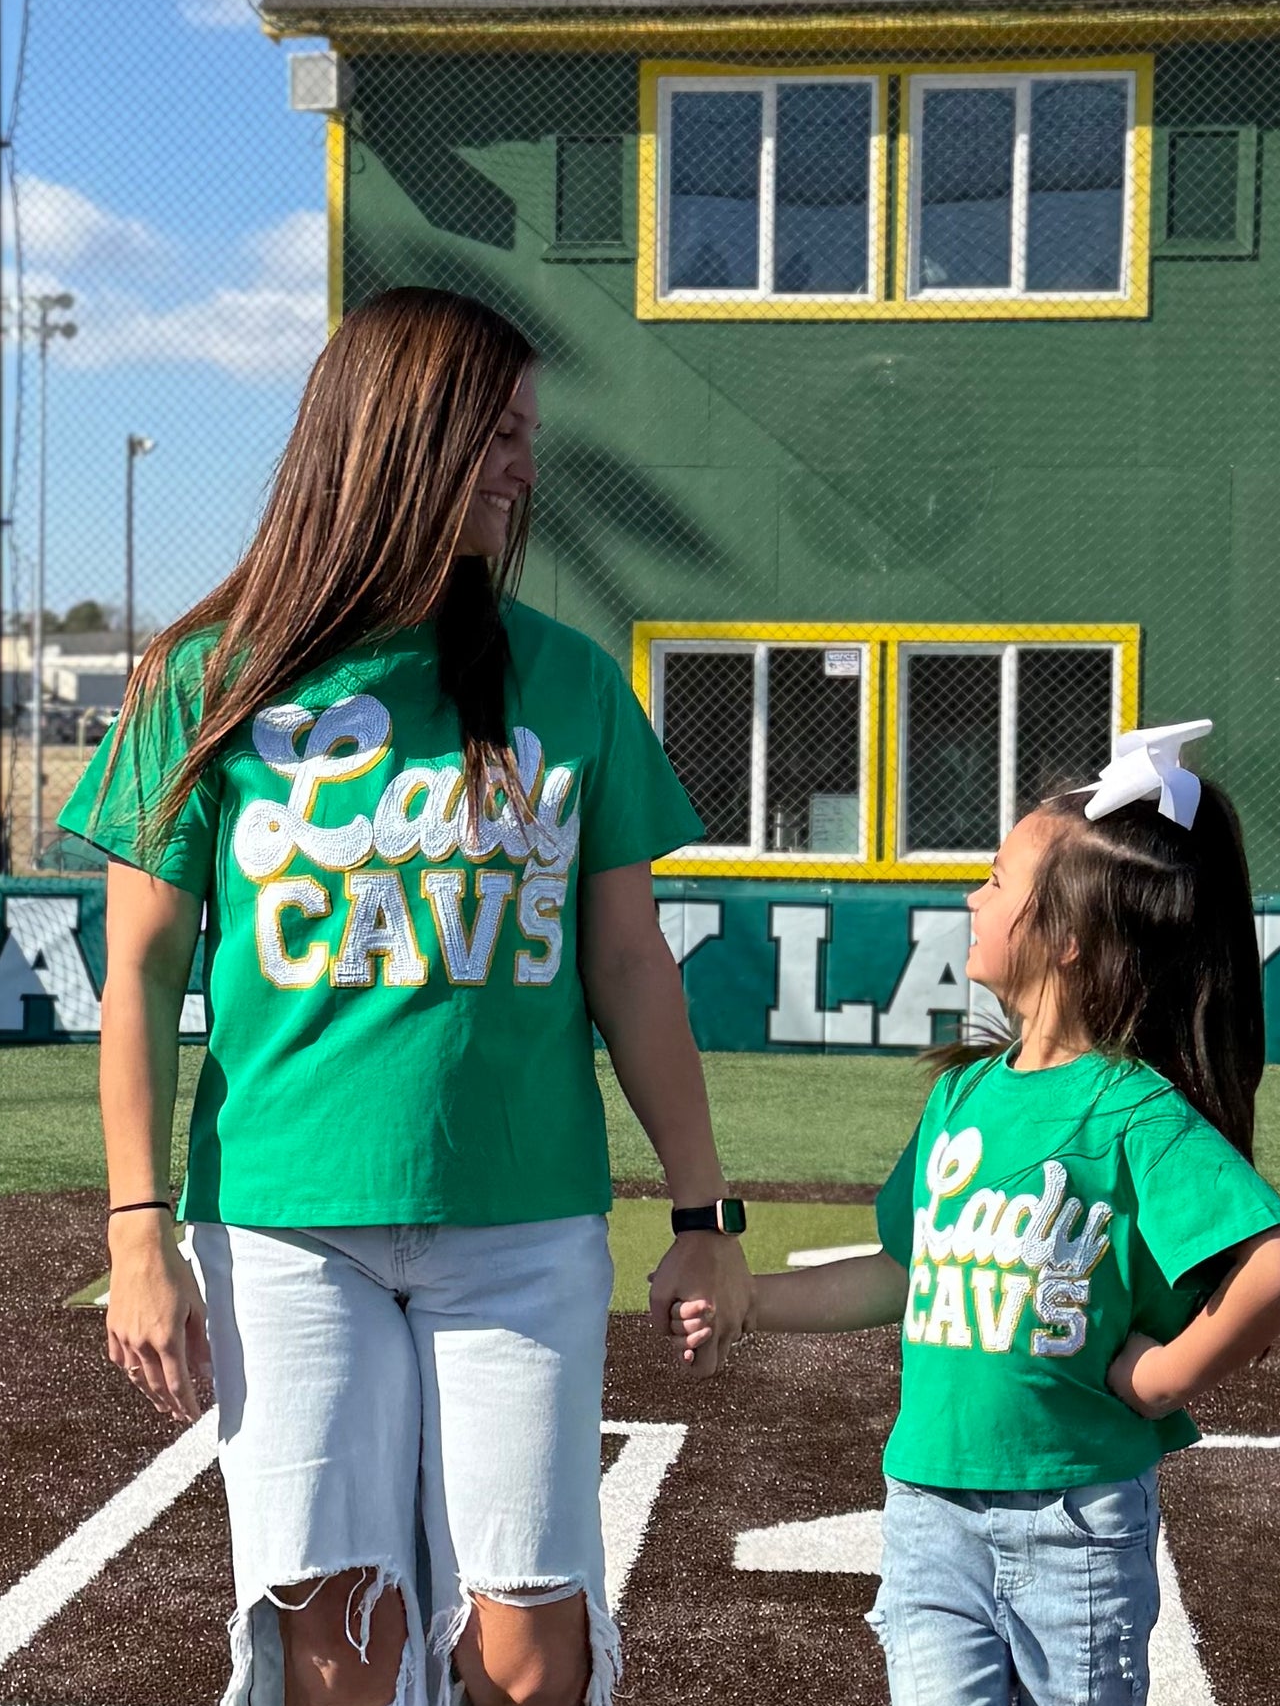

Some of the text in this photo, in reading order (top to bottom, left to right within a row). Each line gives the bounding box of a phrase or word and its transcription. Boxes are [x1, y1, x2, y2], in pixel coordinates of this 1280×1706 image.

[233, 693, 581, 881] Lady
[256, 869, 568, 989] CAVS
[913, 1126, 1113, 1281] Lady
[905, 1264, 1090, 1357] CAVS
